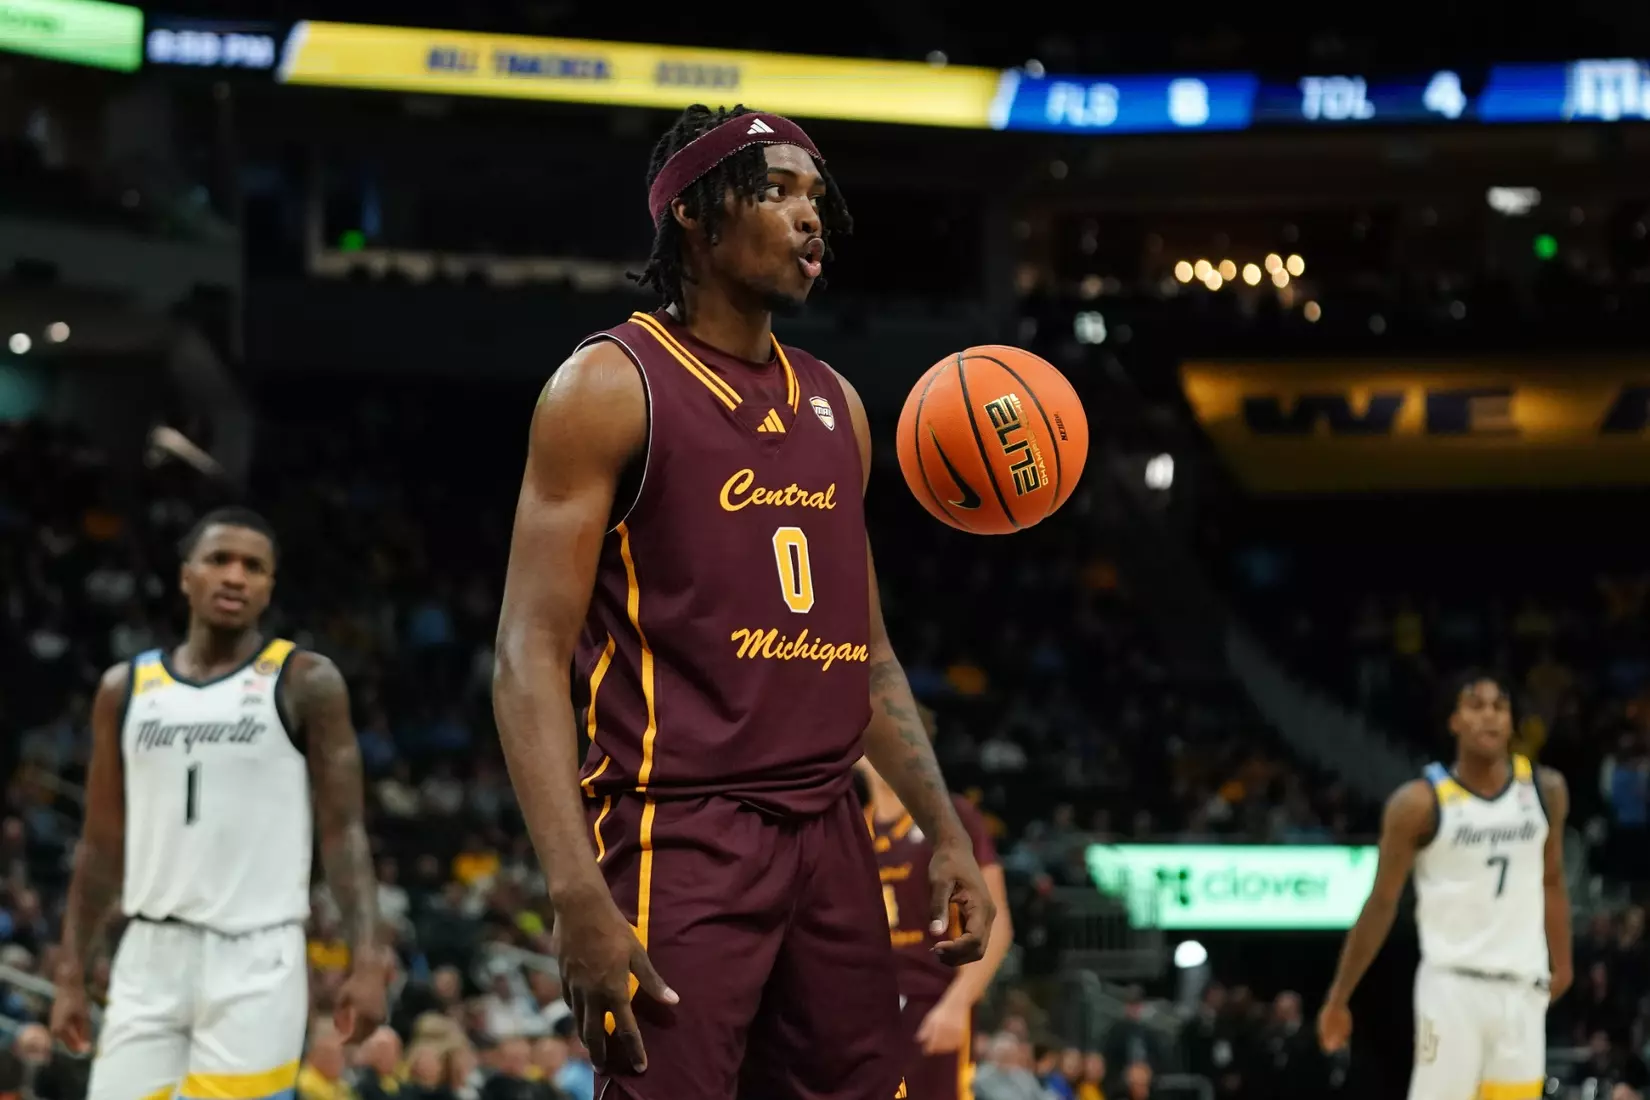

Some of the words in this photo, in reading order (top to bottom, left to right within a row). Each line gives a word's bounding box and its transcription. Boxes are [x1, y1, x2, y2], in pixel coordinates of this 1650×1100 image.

[1045, 80, 1119, 127] FLS
[1299, 74, 1375, 120] TOL
[1422, 69, 1467, 119] 4
[983, 395, 1041, 496] ELITE
[1009, 393, 1049, 486] CHAMPIOHIP
[719, 468, 836, 511] Central
[772, 526, 814, 613] 0
[731, 628, 868, 671] Michigan
[136, 715, 267, 754] Marquette
[185, 763, 199, 826] 1
[1203, 865, 1329, 902] clover
[1486, 855, 1510, 900] 7
